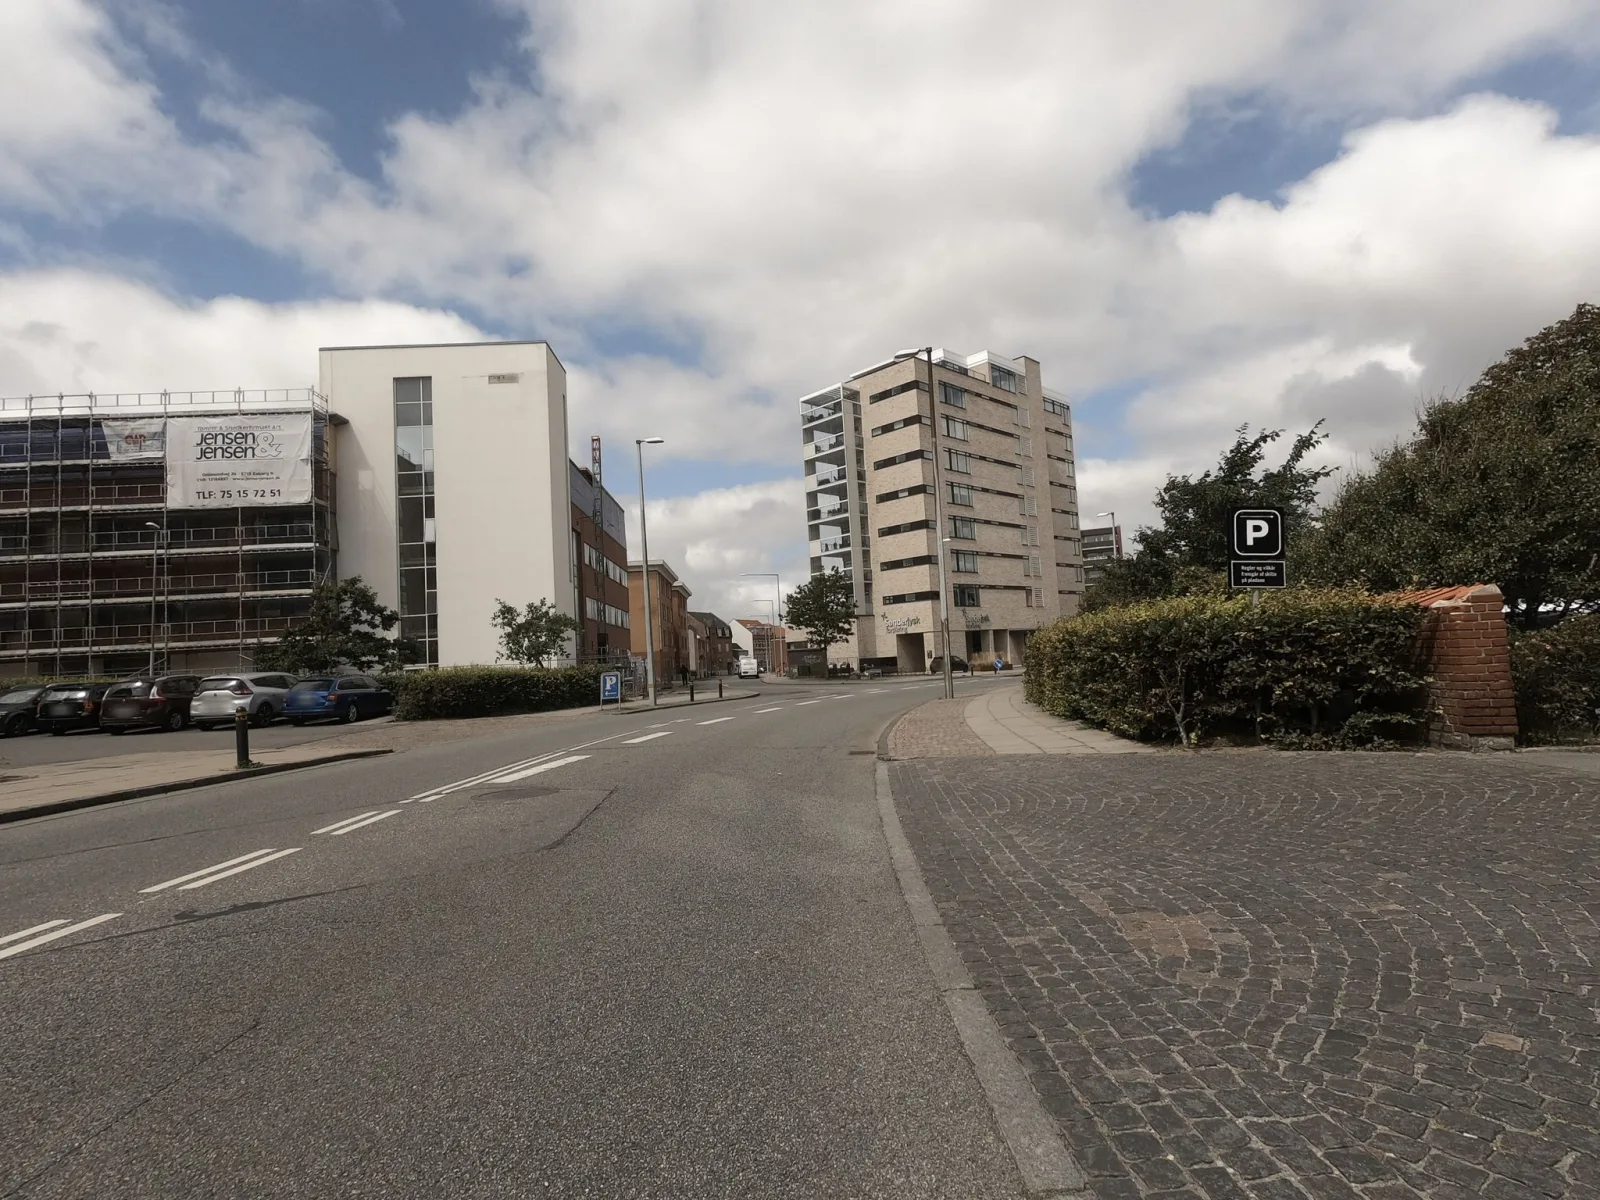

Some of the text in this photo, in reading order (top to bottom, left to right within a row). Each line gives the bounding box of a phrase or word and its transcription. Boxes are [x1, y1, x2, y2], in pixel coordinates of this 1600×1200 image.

[196, 489, 281, 499] TLF: 75 15 72 51
[1246, 520, 1269, 545] P
[605, 676, 617, 690] P
